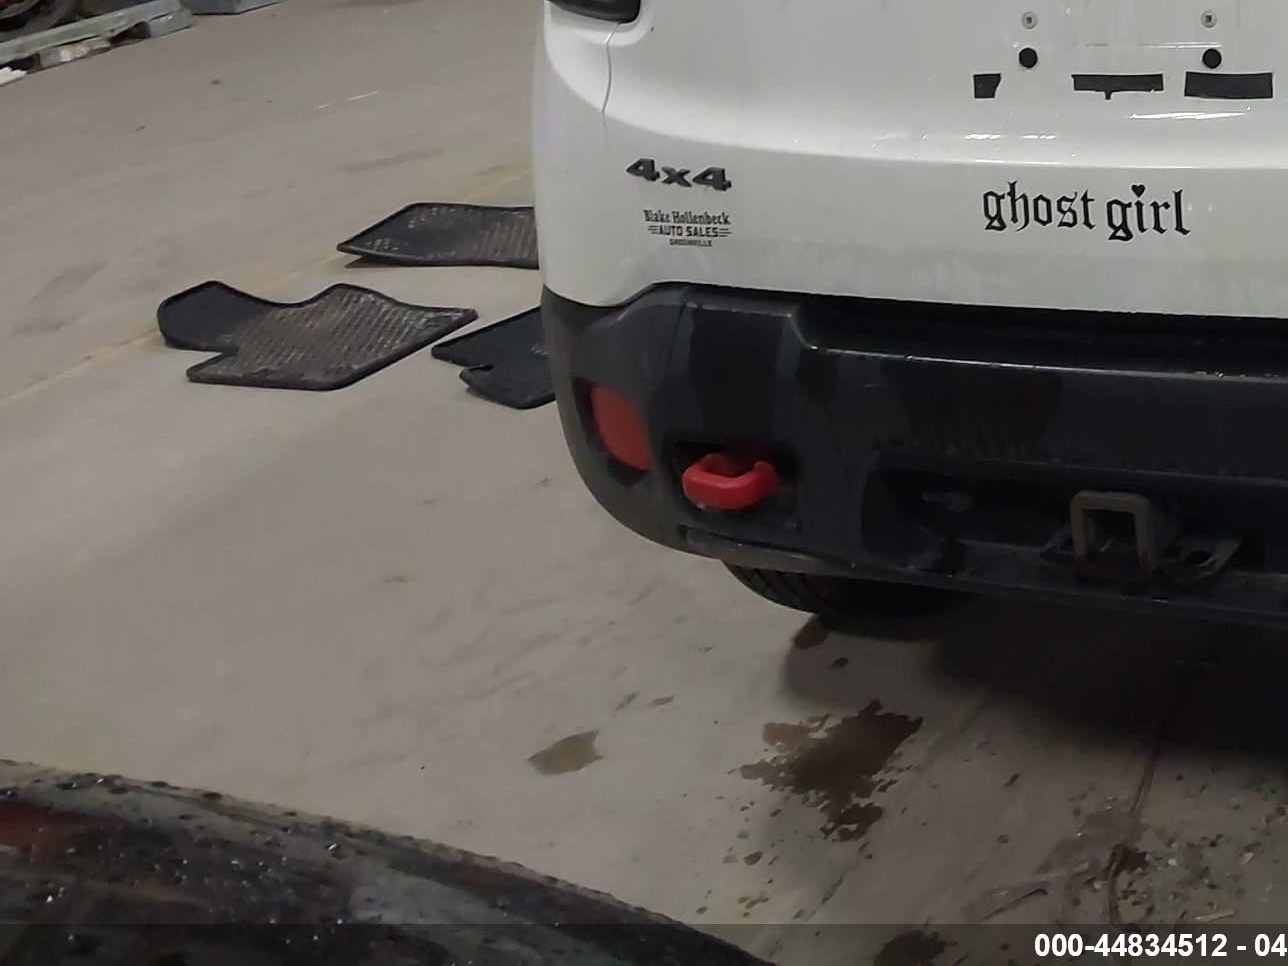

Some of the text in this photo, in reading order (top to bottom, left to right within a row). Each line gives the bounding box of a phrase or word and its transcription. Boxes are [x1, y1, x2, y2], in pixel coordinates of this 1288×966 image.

[626, 158, 732, 192] 4x4
[983, 181, 1191, 242] ghost girl
[658, 225, 719, 238] AUTO SALES
